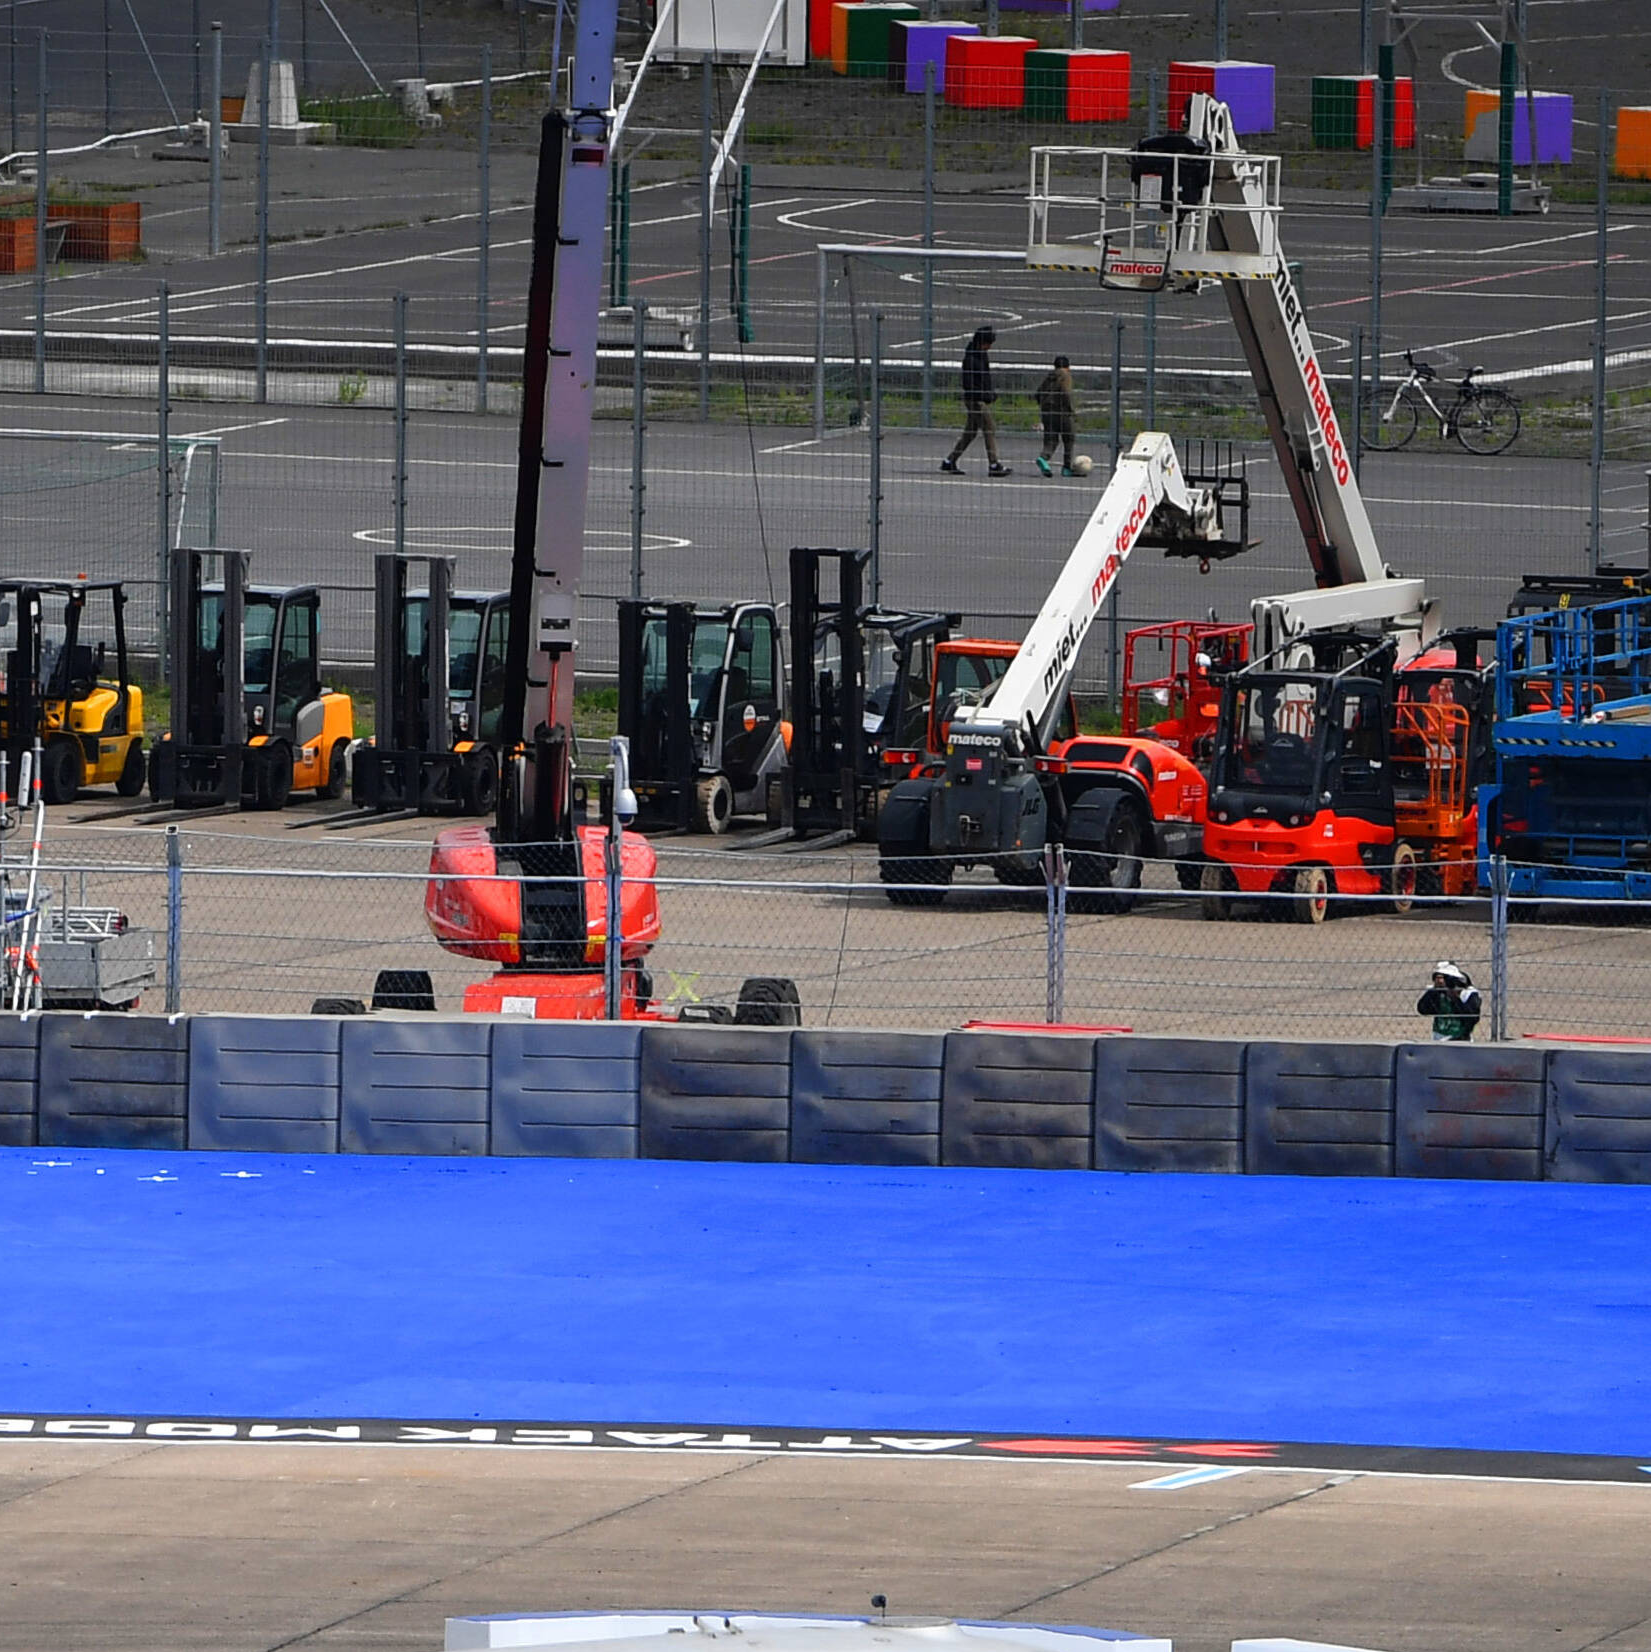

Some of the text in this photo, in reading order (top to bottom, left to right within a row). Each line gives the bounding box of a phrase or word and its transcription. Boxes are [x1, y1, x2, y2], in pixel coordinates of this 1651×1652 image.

[1110, 262, 1163, 274] mateco
[1304, 355, 1349, 487] mateco
[948, 733, 1002, 747] mateco
[397, 1426, 973, 1451] ATTACK
